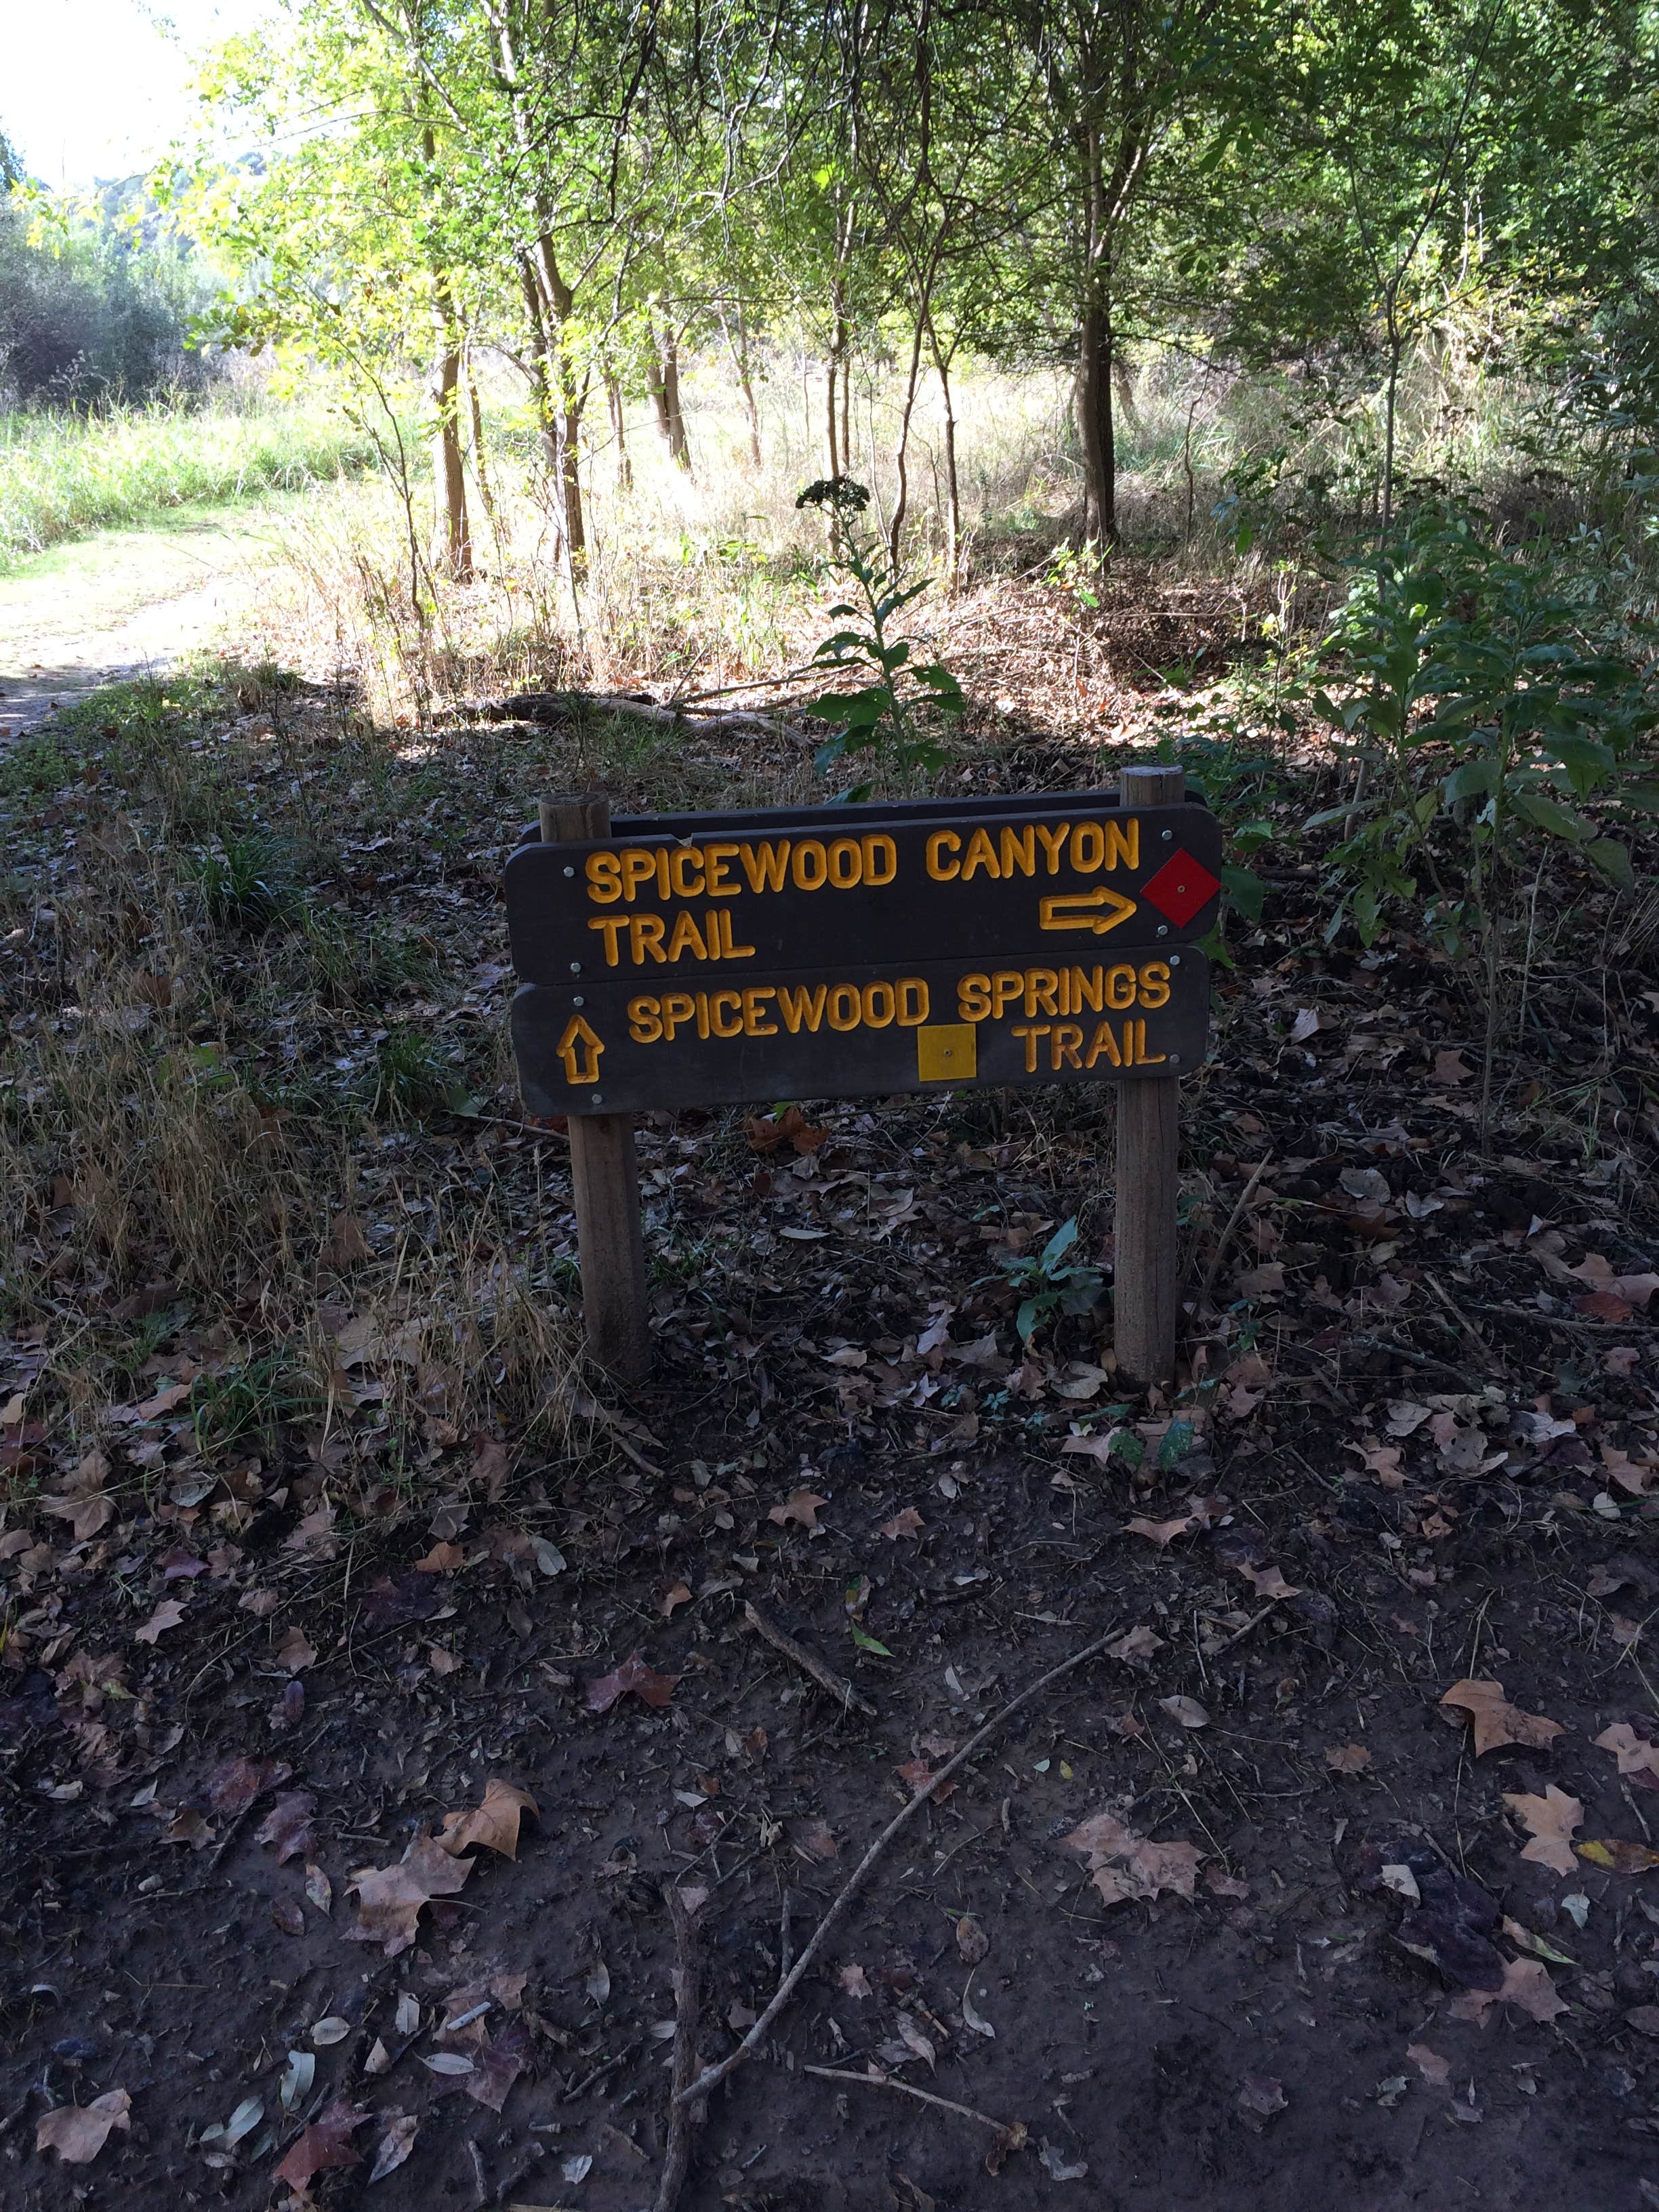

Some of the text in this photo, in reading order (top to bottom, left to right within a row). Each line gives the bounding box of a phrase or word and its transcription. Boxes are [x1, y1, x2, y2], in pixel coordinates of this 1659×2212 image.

[586, 818, 1140, 905] SPICEWOOD CANYON
[588, 909, 757, 966] TRAIL
[628, 962, 1171, 1044] SPICEWOOD SPRINGS
[1011, 1018, 1167, 1073] TRAIL
